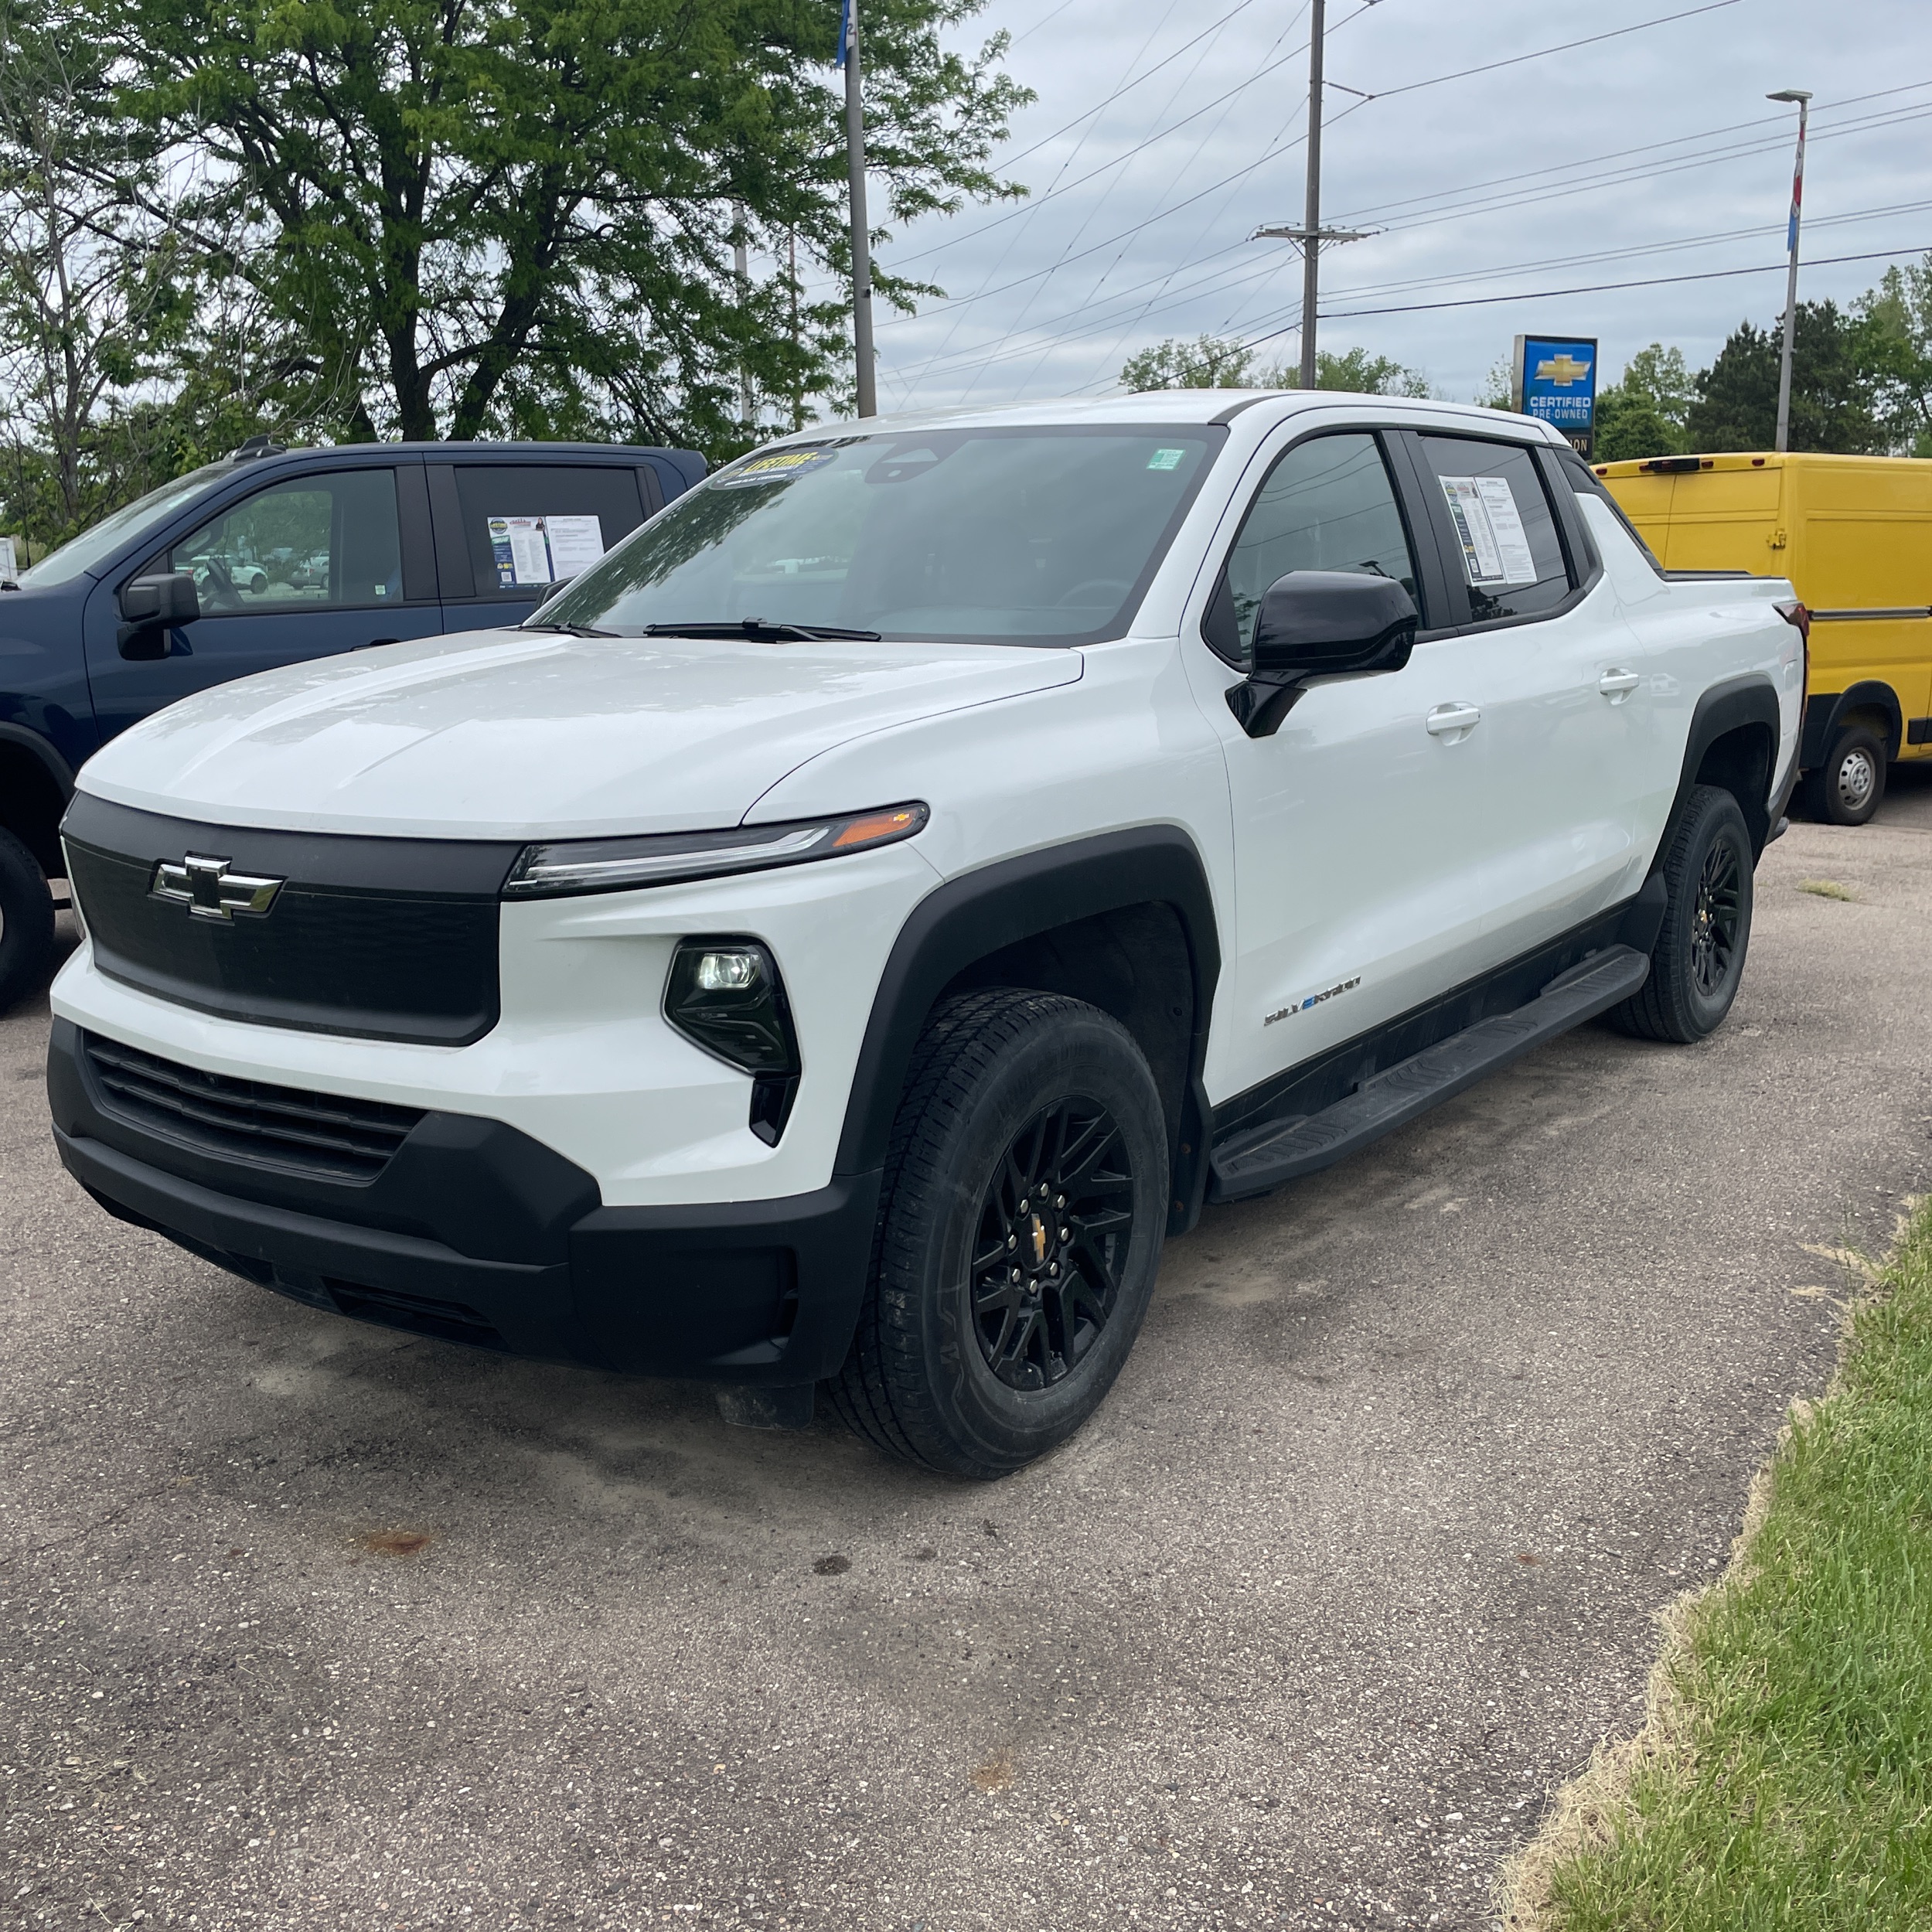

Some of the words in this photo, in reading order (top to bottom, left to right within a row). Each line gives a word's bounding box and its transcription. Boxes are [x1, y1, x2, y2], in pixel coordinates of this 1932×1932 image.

[1530, 397, 1591, 407] CERTIFIED
[1532, 408, 1588, 419] PRE-OWNED
[742, 451, 818, 474] LIFETIME
